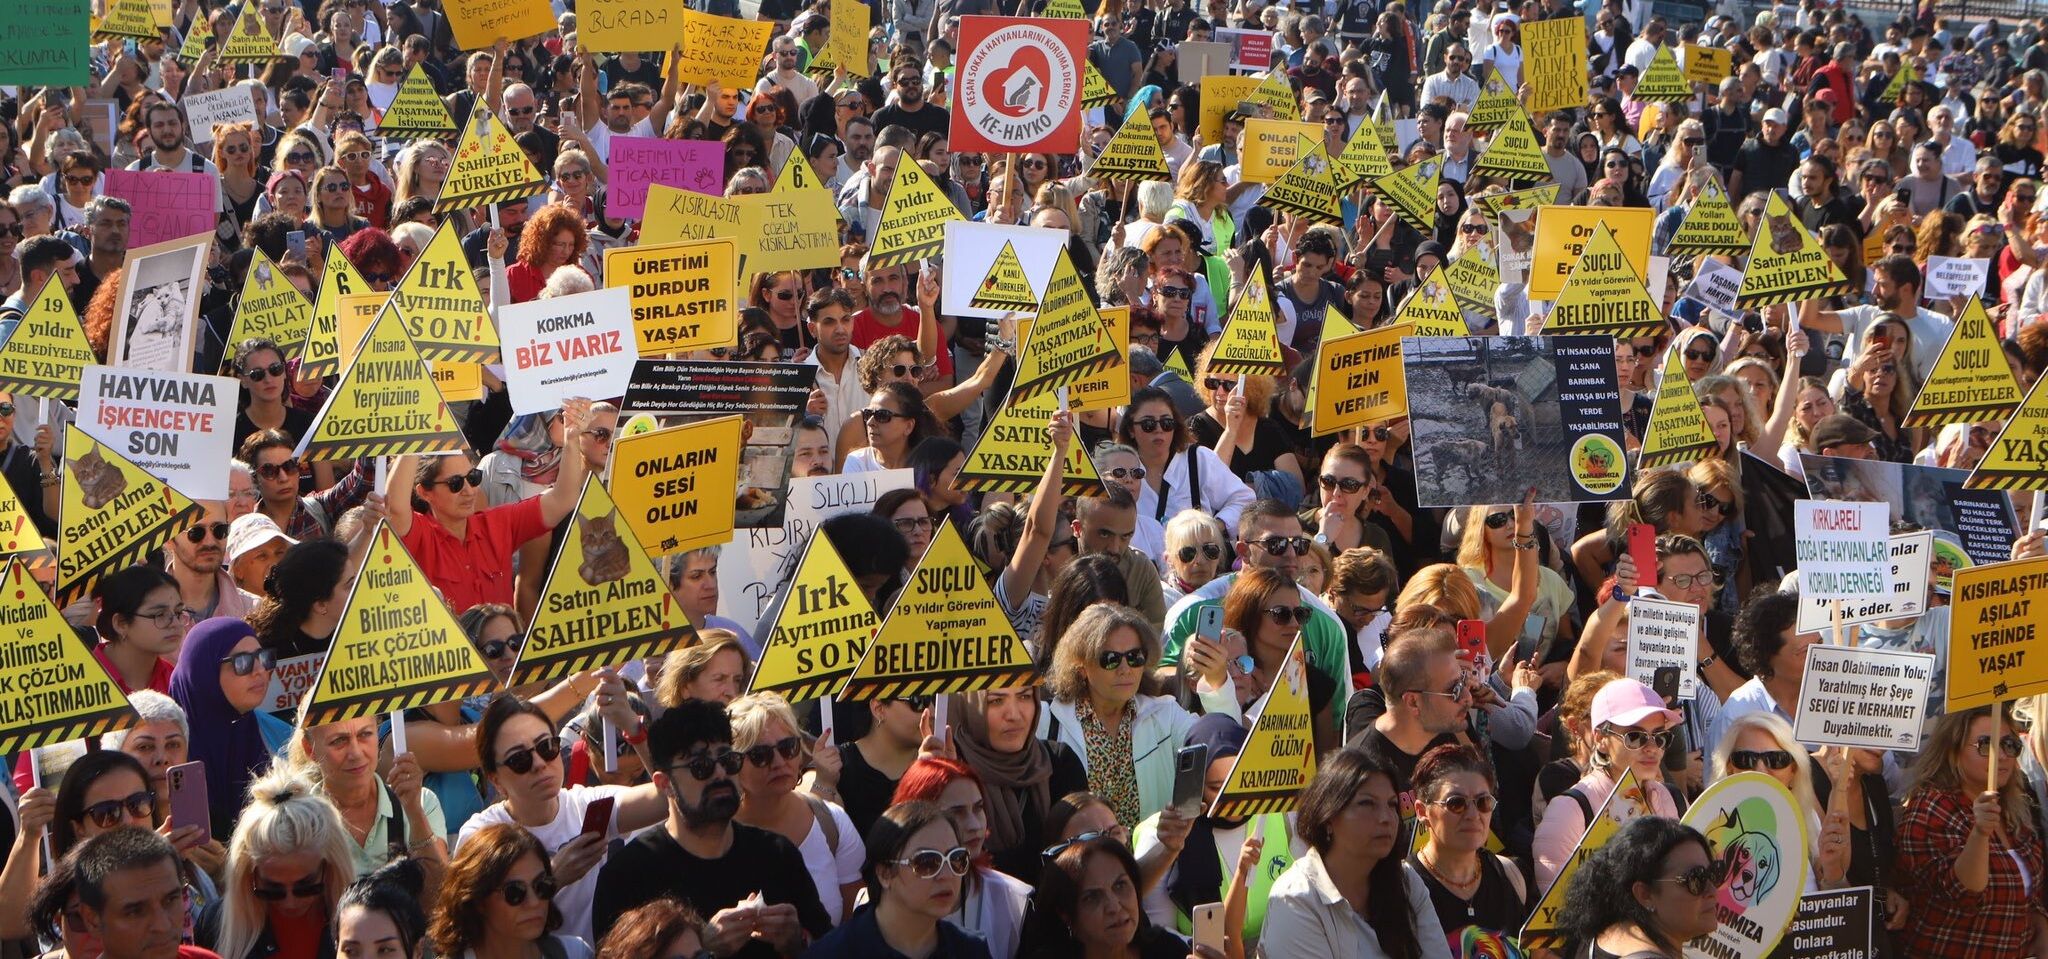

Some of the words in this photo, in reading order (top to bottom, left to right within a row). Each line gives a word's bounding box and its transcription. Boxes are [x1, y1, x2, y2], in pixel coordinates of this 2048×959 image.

[589, 8, 668, 33] BURADA
[969, 50, 987, 77] SOKAK
[986, 30, 1045, 52] HAYVANLARINI
[1044, 38, 1069, 71] KORUMA
[1058, 71, 1071, 109] DERNEĞİ
[393, 108, 443, 118] YAŞATMAK
[979, 112, 1052, 140] KE-HAYKO
[1118, 132, 1155, 142] Dokunma!
[1361, 127, 1372, 137] 19
[1509, 120, 1526, 132] ASIL
[1352, 141, 1377, 151] yıldır
[457, 152, 520, 172] SAHİPLEN
[1340, 154, 1387, 163] BELEDİYELER
[1483, 157, 1544, 169] BELEDİYELER
[901, 171, 919, 187] 19
[766, 204, 796, 218] TEK
[894, 190, 935, 213] yıldır
[1696, 201, 1728, 209] Avrupa
[883, 205, 956, 232] BELEDİYELER
[1699, 210, 1724, 219] Yolları
[1685, 222, 1710, 230] FARE
[1712, 222, 1738, 231] DOLU
[633, 251, 709, 276] ÜRETİMİ
[1582, 253, 1622, 275] SUÇLU
[1753, 258, 1786, 270] Satın
[1790, 252, 1822, 265] Alma
[419, 261, 465, 290] Irk
[1570, 278, 1579, 288] 19
[1581, 277, 1602, 287] Yıldır
[1602, 275, 1636, 286] Görevini
[1744, 261, 1834, 291] SAHİPLEN!
[633, 278, 710, 298] DURDUR
[1589, 287, 1630, 298] Yapmayan
[43, 297, 63, 313] 19
[1235, 309, 1271, 323] HAYVAN
[1406, 306, 1459, 323] HAYVAN
[1556, 298, 1650, 327] BELEDİYELER
[29, 321, 74, 339] yıldır
[242, 304, 307, 335] AŞILAT
[537, 312, 595, 334] KORKMA
[1035, 317, 1071, 336] Uyutmak
[1072, 308, 1091, 323] değil
[1960, 319, 1986, 339] ASIL
[373, 335, 405, 353] İnsana
[643, 325, 700, 344] YAŞAT
[1030, 321, 1097, 357] YAŞATMAK
[1236, 328, 1267, 344] YAŞAM
[8, 341, 91, 361] BELEDİYELER
[516, 339, 553, 370] BİZ
[556, 330, 623, 363] VARIZ
[1330, 343, 1400, 371] ÜRETİME
[1567, 348, 1590, 356] İNSAN
[1591, 347, 1611, 355] OĞLU
[1953, 349, 1990, 373] SUÇLU
[356, 360, 422, 383] HAYVANA
[1347, 370, 1379, 390] İZİN
[99, 373, 216, 407] HAYVANA
[354, 387, 420, 411] Yeryüzüne
[1561, 393, 1575, 401] SEN
[1575, 394, 1594, 402] YAŞA
[1606, 391, 1618, 399] PİS
[1922, 386, 2015, 406] BELEDİYELER
[1334, 391, 1389, 416] VERME
[98, 401, 214, 433] İŞKENCEYE
[1568, 422, 1618, 431] YAŞABİLİRSEN
[128, 431, 179, 456] SON
[635, 447, 717, 478] ONLARIN
[653, 471, 695, 499] SESİ
[64, 509, 111, 543] Satın
[113, 481, 156, 515] Alma
[646, 500, 698, 524] OLUN
[365, 565, 413, 590] Vicdani
[917, 565, 976, 598] SUÇLU
[1808, 571, 1838, 594] KORUMA
[1840, 568, 1885, 593] DERNEĞİ
[384, 592, 399, 604] Ve
[549, 587, 600, 614] Satın
[606, 577, 656, 602] Alma
[798, 574, 850, 616] Irk
[359, 599, 428, 634] Bilimsel
[896, 603, 910, 616] 19
[913, 601, 945, 615] Yıldır
[946, 597, 995, 612] Görevini
[1634, 606, 1642, 617] Bir
[1979, 600, 2030, 626] AŞILAT
[17, 627, 34, 639] Ve
[772, 610, 876, 648] Ayrımına
[926, 617, 986, 632] Yapmayan
[345, 640, 380, 661] TEK
[384, 628, 447, 655] ÇÖZÜM
[1971, 624, 2035, 650] YERİNDE
[874, 632, 1013, 675] BELEDİYELER
[1672, 644, 1685, 654] olan
[328, 646, 472, 694] KISIRLAŞTIRMADIR
[1812, 654, 1838, 672] İnsan
[1842, 660, 1900, 677] Olabilmenin
[1904, 665, 1927, 681] Yolu;
[1979, 650, 2025, 675] YAŞAT
[18, 663, 85, 694] ÇÖZÜM
[1819, 679, 1867, 699] Yaratılmış
[1870, 683, 1887, 697] Her
[1890, 684, 1913, 701] Şeye
[1809, 697, 1839, 712] SEVGİ
[1842, 701, 1855, 715] VE
[1858, 703, 1915, 719] MERHAMET
[1824, 720, 1893, 738] Duyabilmektir.
[1270, 734, 1304, 757] ÖLÜM
[1794, 935, 1833, 950] Onlara
